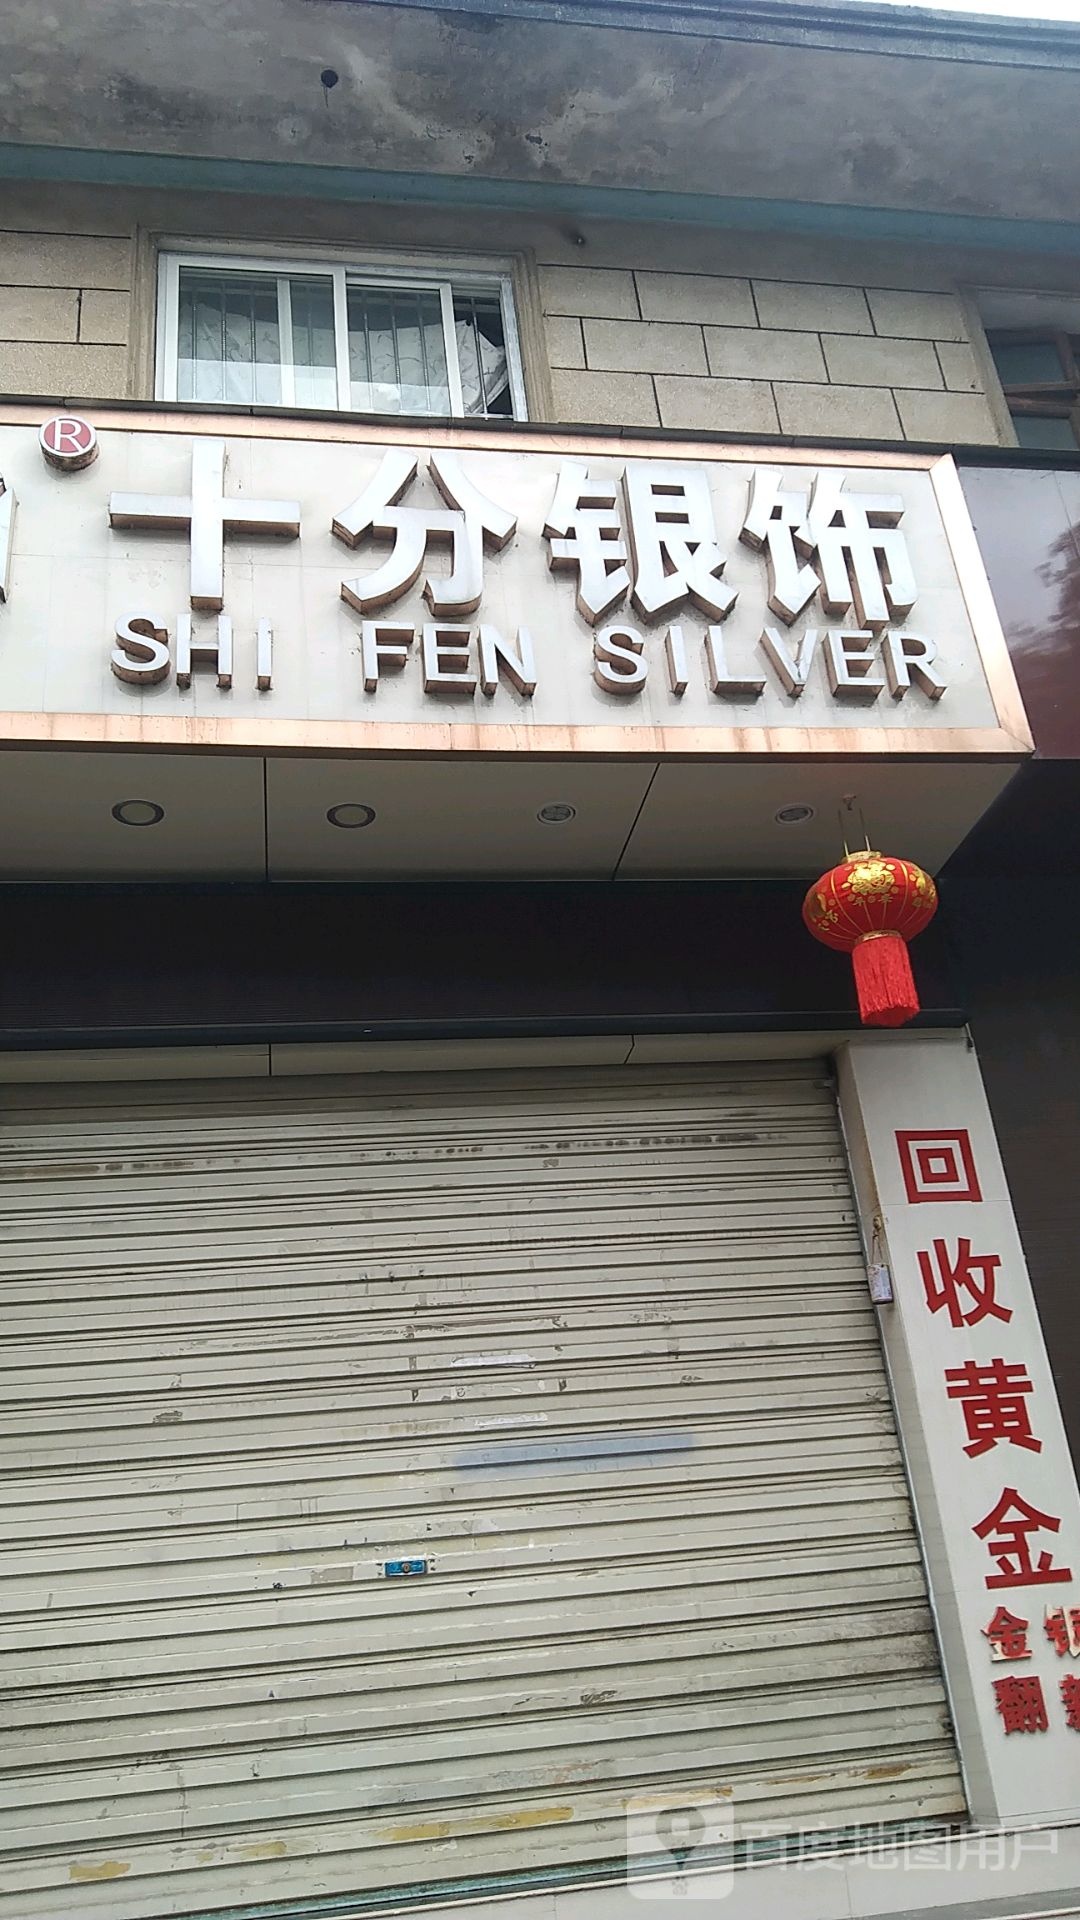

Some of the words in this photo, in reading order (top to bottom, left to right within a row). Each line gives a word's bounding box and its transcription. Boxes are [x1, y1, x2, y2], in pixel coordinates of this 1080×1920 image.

[109, 438, 918, 627] 十分银饰
[110, 611, 274, 690] SHI
[361, 619, 538, 697] FEN
[593, 624, 948, 702] SILVER
[895, 1128, 1073, 1590] 回收黄金
